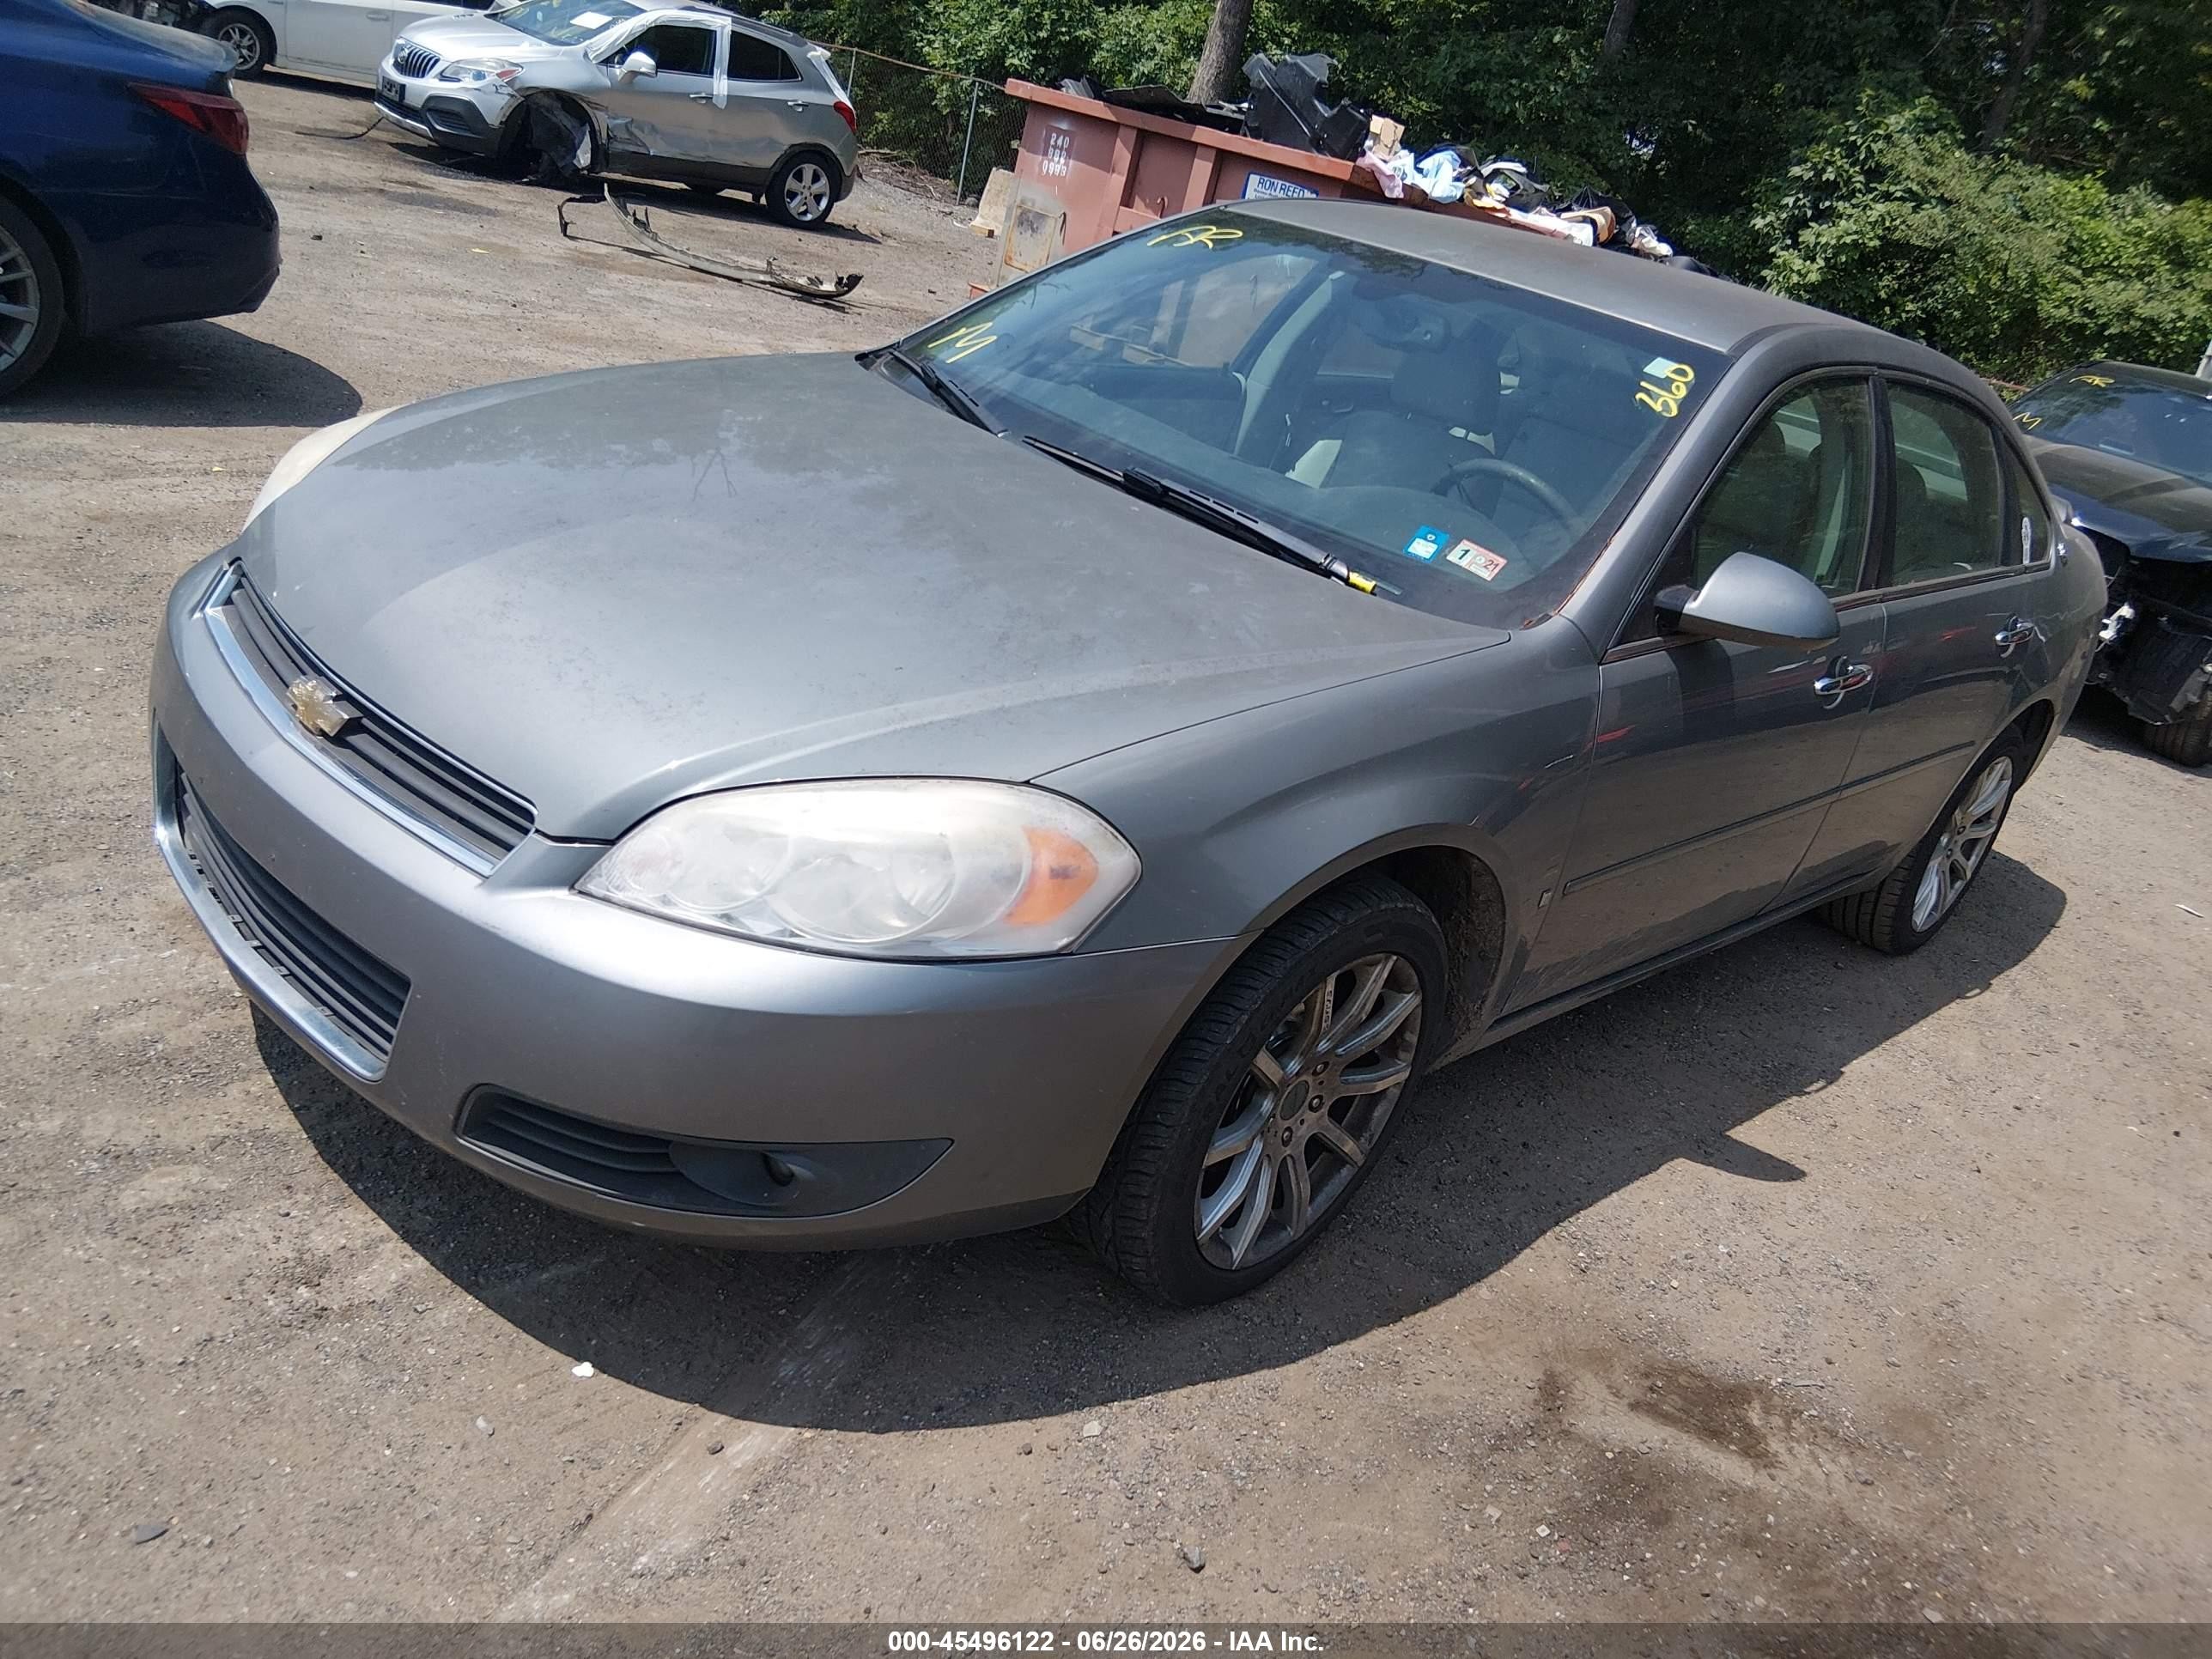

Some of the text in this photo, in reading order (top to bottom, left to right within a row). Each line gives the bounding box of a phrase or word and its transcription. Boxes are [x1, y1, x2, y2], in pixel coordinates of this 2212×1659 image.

[1256, 177, 1279, 193] RON
[1458, 549, 1500, 572] 1 21
